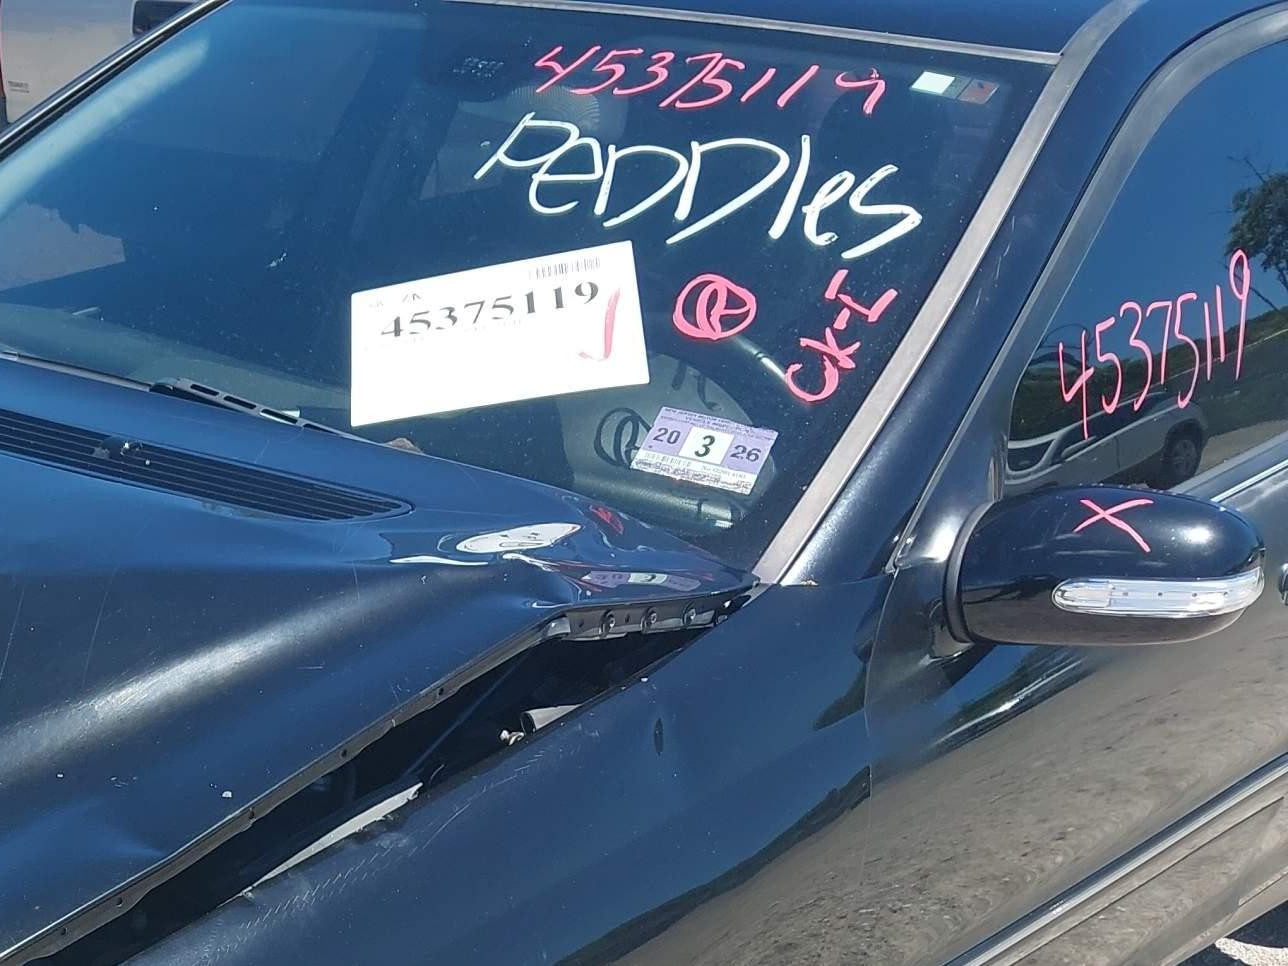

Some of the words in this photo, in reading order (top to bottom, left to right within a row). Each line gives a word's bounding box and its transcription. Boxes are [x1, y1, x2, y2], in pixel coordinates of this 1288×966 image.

[535, 46, 885, 113] 45375119
[380, 281, 600, 338] 45375119
[1057, 249, 1251, 440] 45375119
[652, 427, 681, 445] 20
[694, 434, 716, 458] 3
[729, 444, 762, 463] 26
